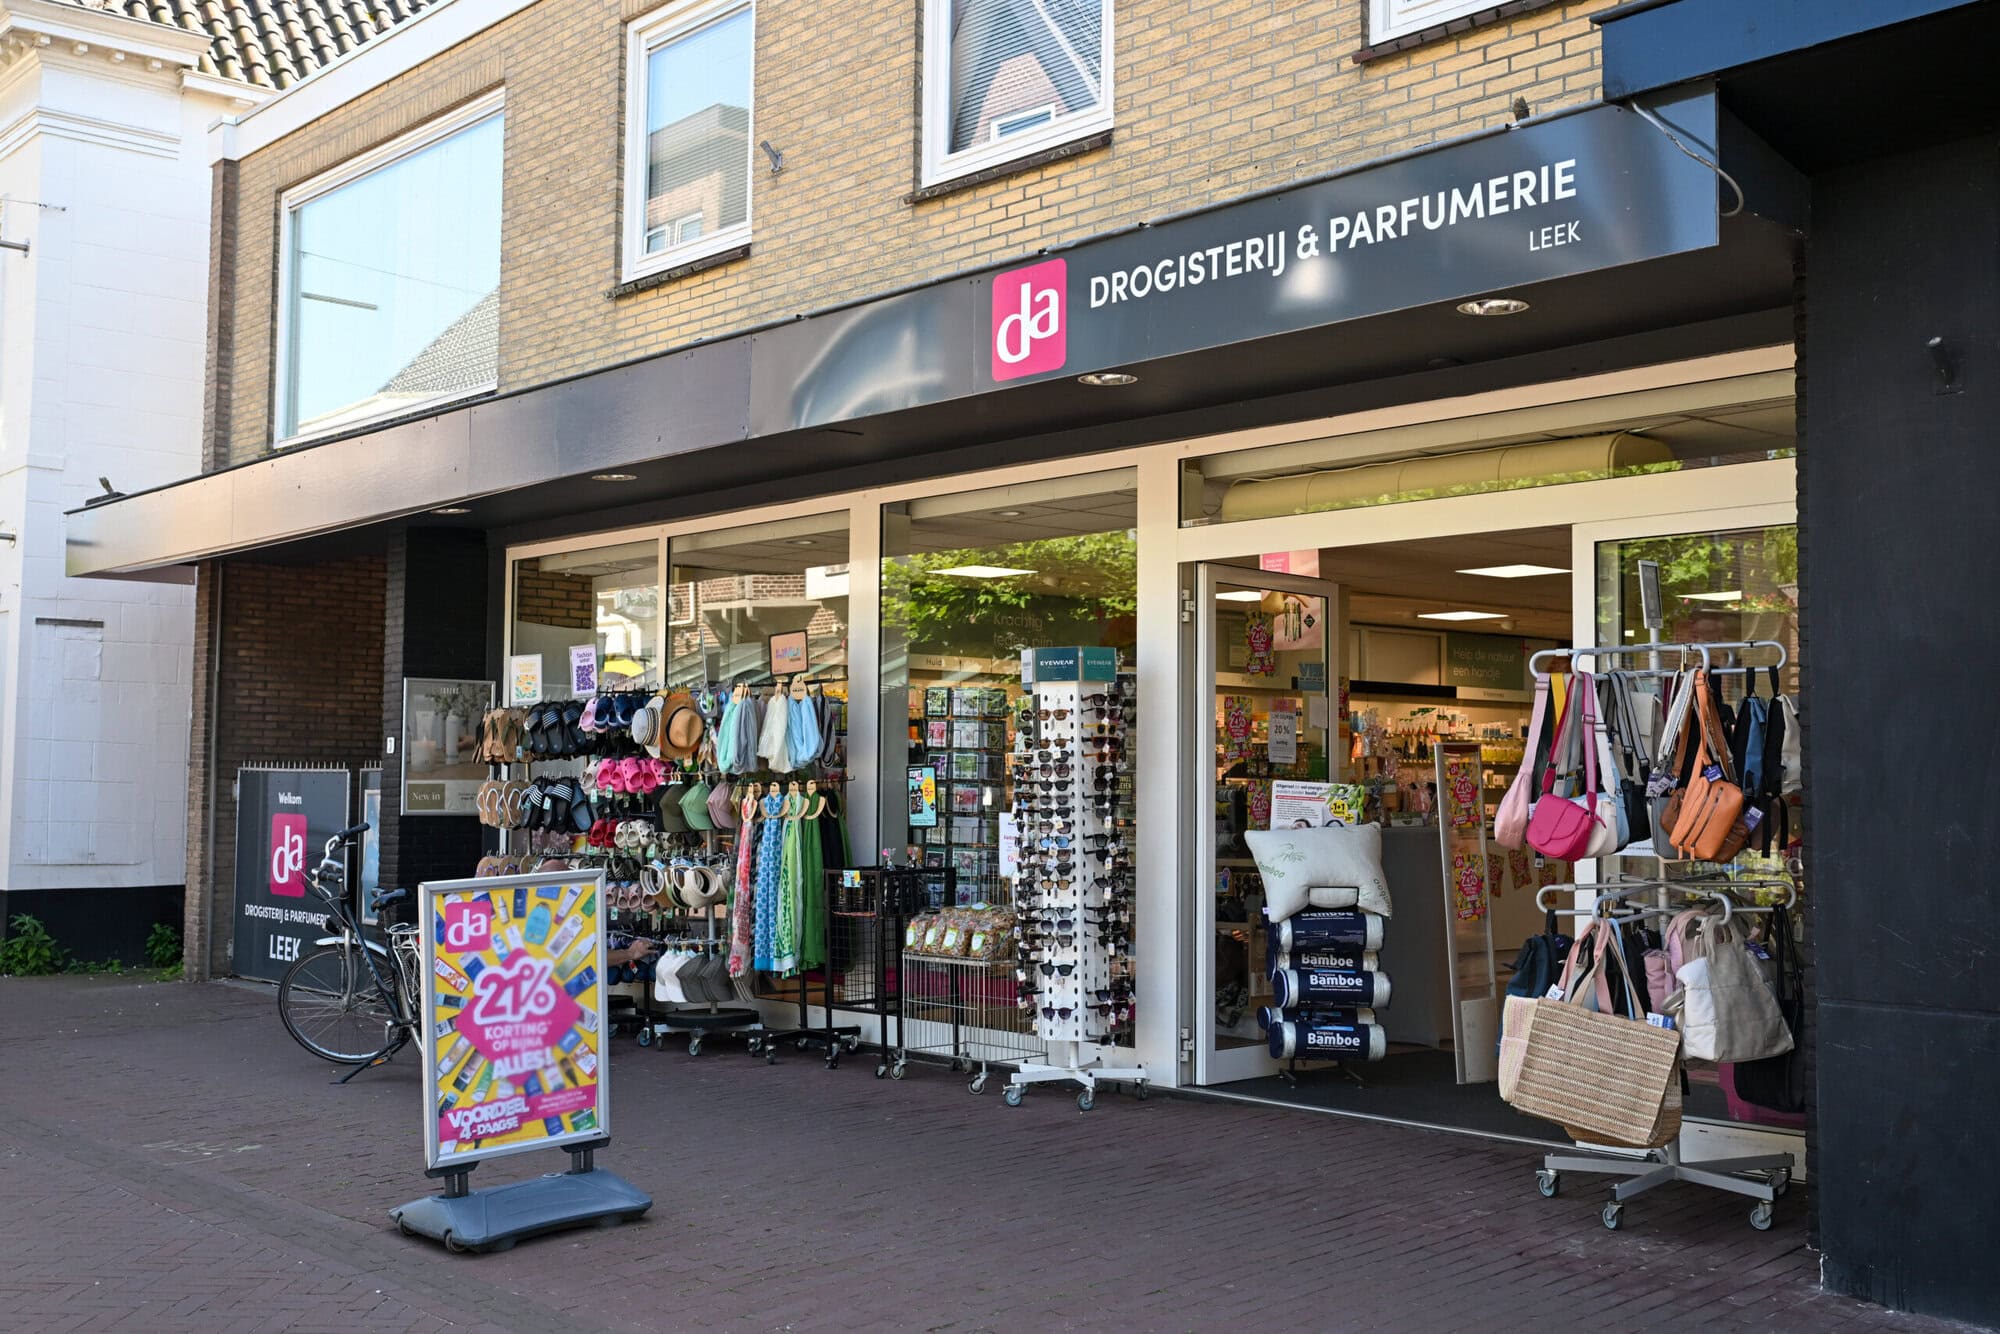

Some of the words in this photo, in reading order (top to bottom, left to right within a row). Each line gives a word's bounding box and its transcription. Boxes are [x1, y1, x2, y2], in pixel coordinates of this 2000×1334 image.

[1089, 232, 1287, 309] DROGISTERIJ
[1296, 225, 1320, 261] &
[1329, 159, 1578, 253] PARFUMERIE
[1529, 220, 1582, 252] LEEK
[996, 282, 1060, 365] da
[278, 792, 302, 805] Welkom
[273, 825, 303, 884] da
[245, 903, 283, 924] DROGISTERIJ
[284, 908, 289, 921] &
[290, 910, 331, 926] PARFUMERI
[447, 909, 487, 947] da
[269, 934, 301, 962] LEEK
[1301, 953, 1354, 967] Bamboe
[478, 962, 551, 1020] 21%
[1309, 974, 1363, 987] Bamboe
[492, 1038, 509, 1052] OP
[1307, 1032, 1361, 1047] Bamboe
[447, 1097, 530, 1128] VOORDEEL
[460, 1116, 519, 1139] 4-DAAGSE
